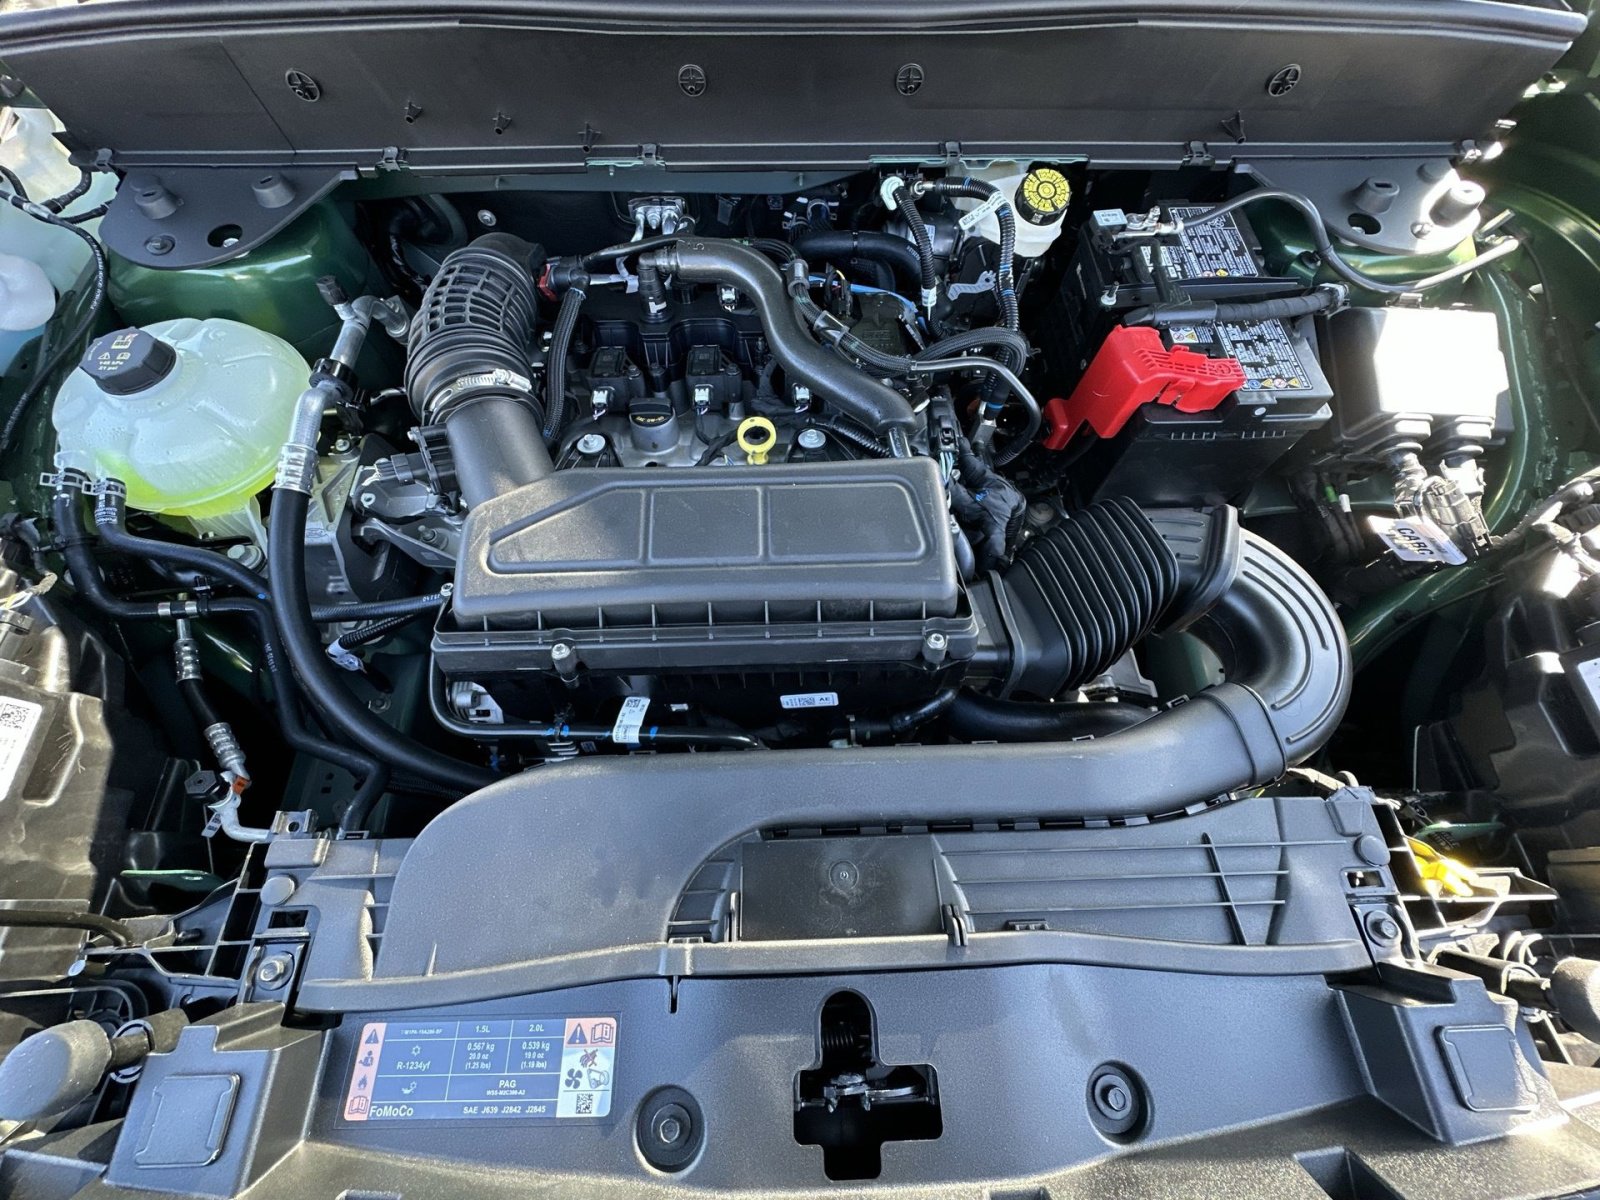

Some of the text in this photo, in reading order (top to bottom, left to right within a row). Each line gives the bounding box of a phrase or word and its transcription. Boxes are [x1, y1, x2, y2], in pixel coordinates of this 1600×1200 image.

[475, 1025, 491, 1033] 1.5L
[528, 1024, 545, 1032] 2.0L
[467, 1042, 495, 1052] 0.567 kg
[521, 1041, 551, 1051] 0.539 kg
[396, 1060, 431, 1072] R-1234yf
[480, 1061, 492, 1070] lbs)
[536, 1060, 548, 1070] lbs)
[498, 1079, 517, 1088] PAG
[369, 1104, 414, 1117] FoMoCo
[463, 1105, 546, 1114] SAE J639 J2842 J2845
